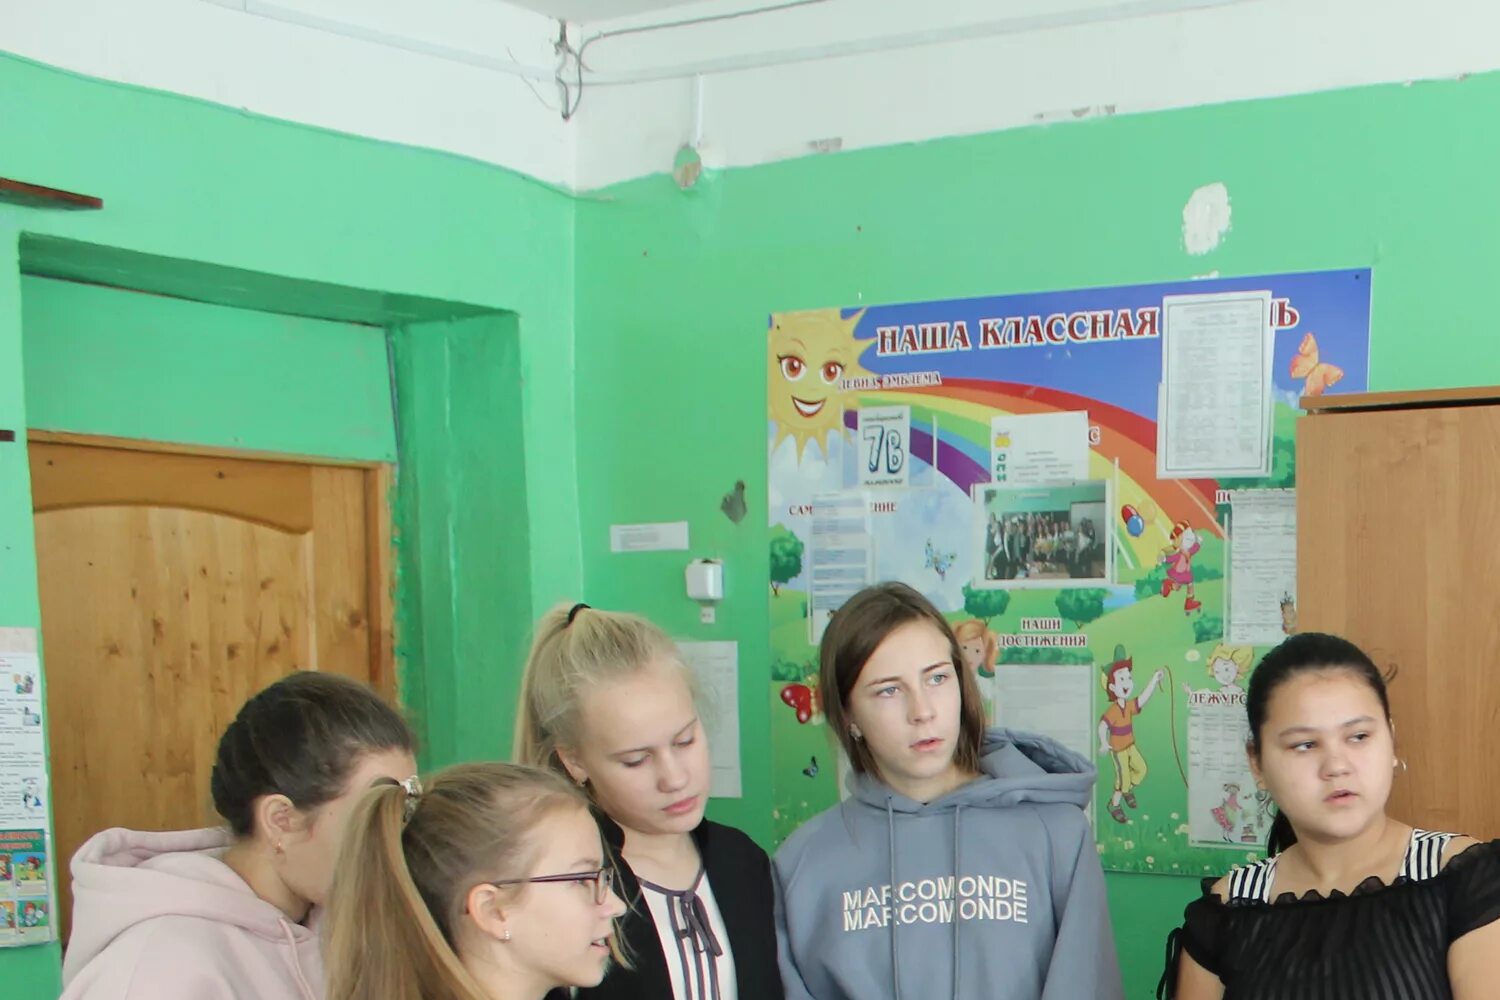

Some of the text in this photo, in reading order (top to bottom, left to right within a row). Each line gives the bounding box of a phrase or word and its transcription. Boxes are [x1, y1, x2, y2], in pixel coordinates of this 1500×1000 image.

[877, 308, 1159, 355] НАША КЛАССНАЯ
[1022, 619, 1061, 630] НАШИ
[998, 635, 1086, 647] ДОСТИЖЕНИЯ
[1189, 692, 1248, 706] ДЕЖУРС
[843, 874, 1028, 911] MARCOMONDE
[843, 897, 1029, 932] MARCOMONDE
